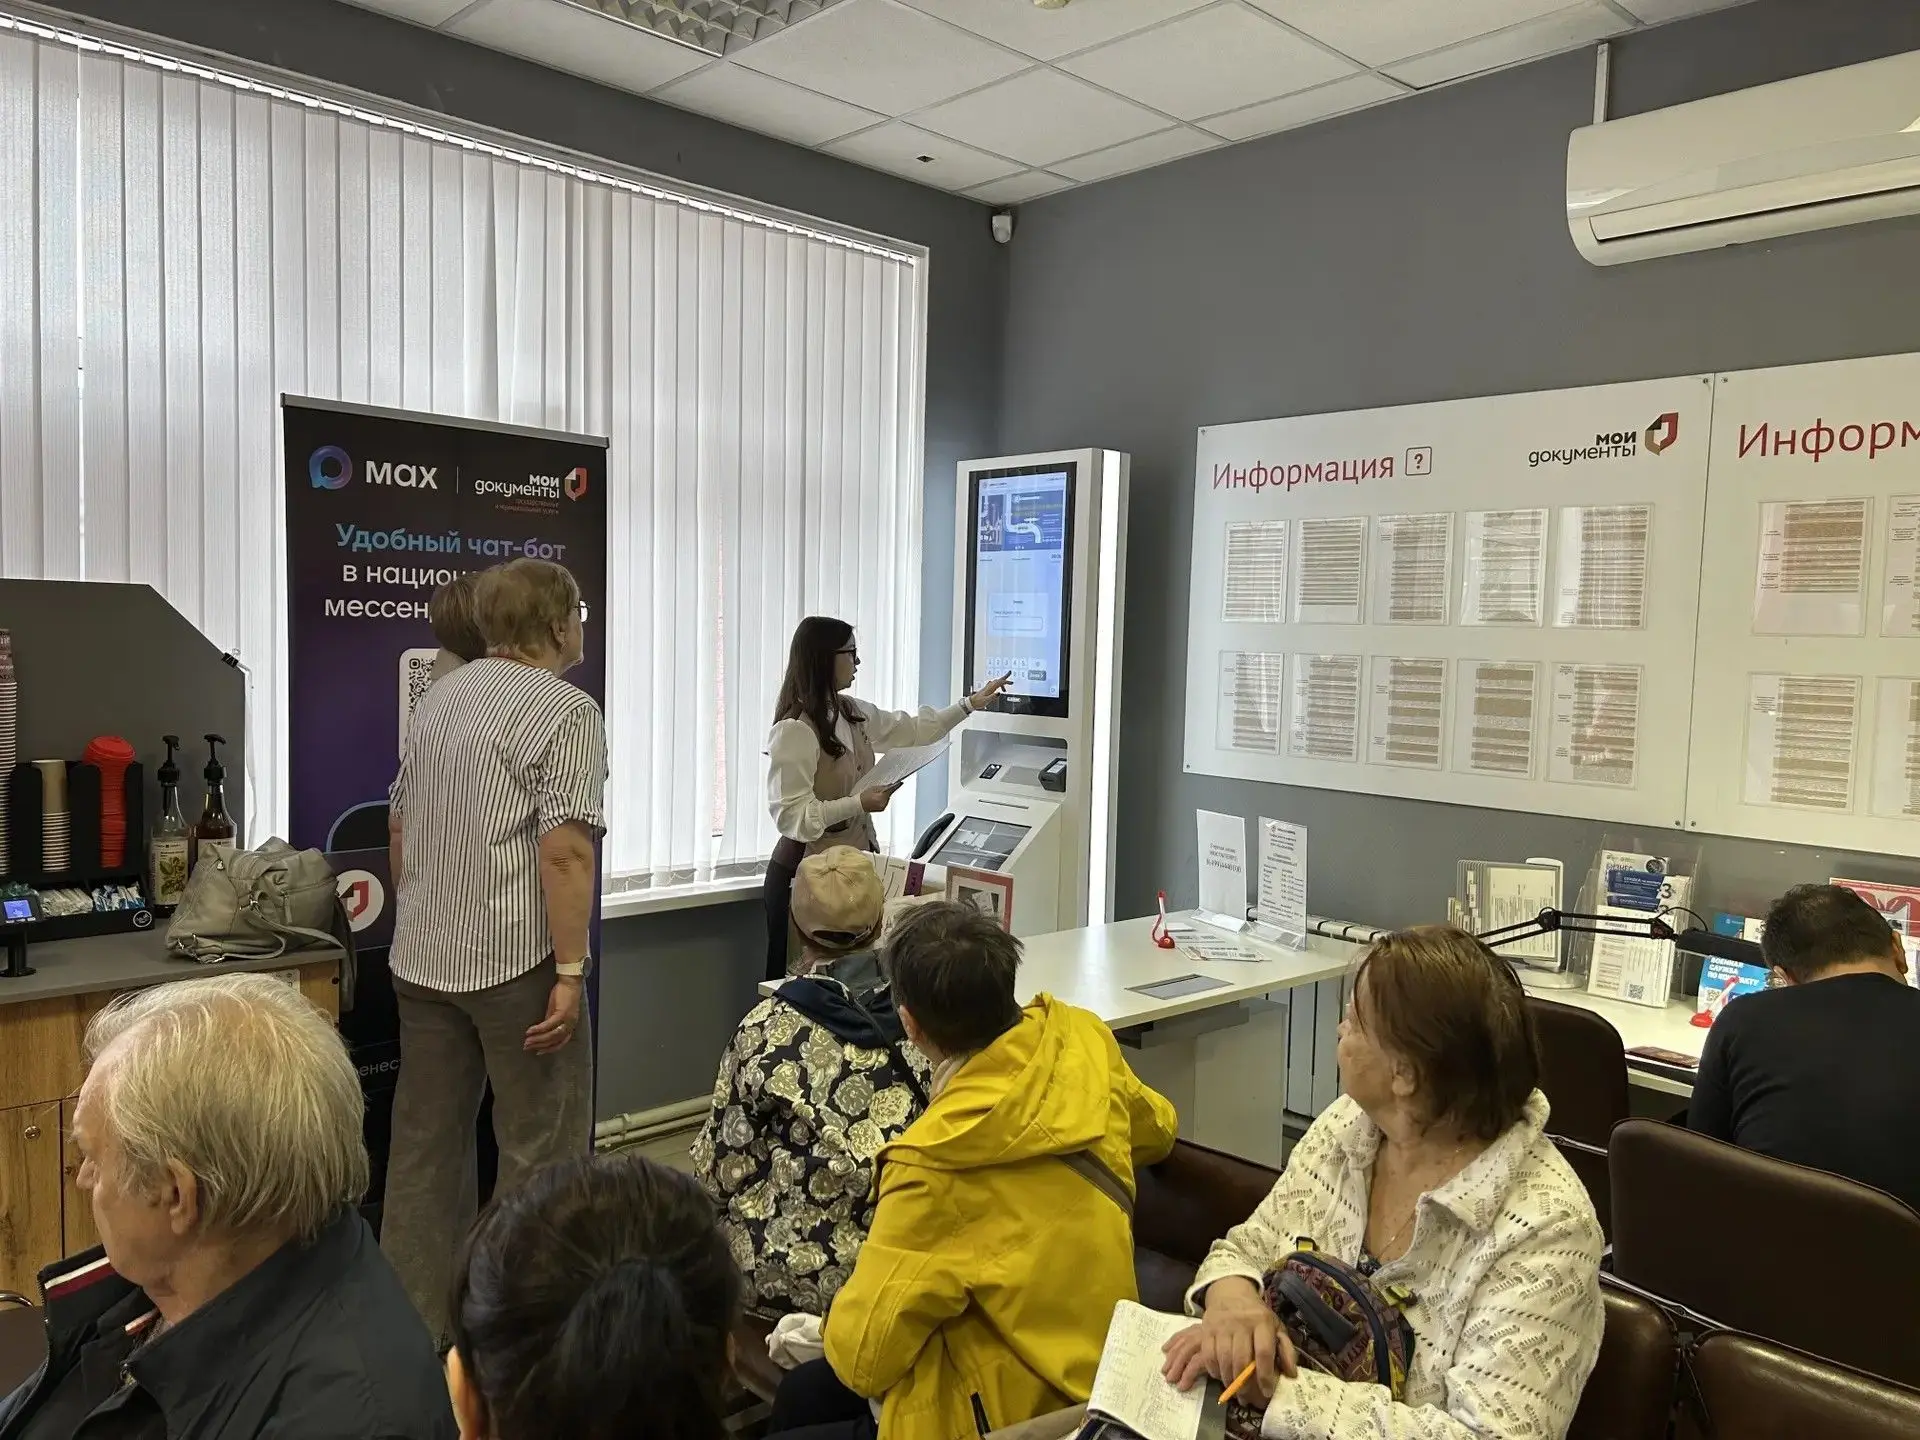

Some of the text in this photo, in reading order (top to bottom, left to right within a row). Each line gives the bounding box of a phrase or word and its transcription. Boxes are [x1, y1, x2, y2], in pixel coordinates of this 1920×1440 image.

[1596, 431, 1637, 446] мои
[1528, 444, 1636, 467] документы
[529, 474, 560, 488] мои
[1213, 456, 1394, 494] Информация
[474, 479, 560, 499] документы
[336, 523, 566, 560] Удобный чат-бот
[325, 598, 433, 624] мессен
